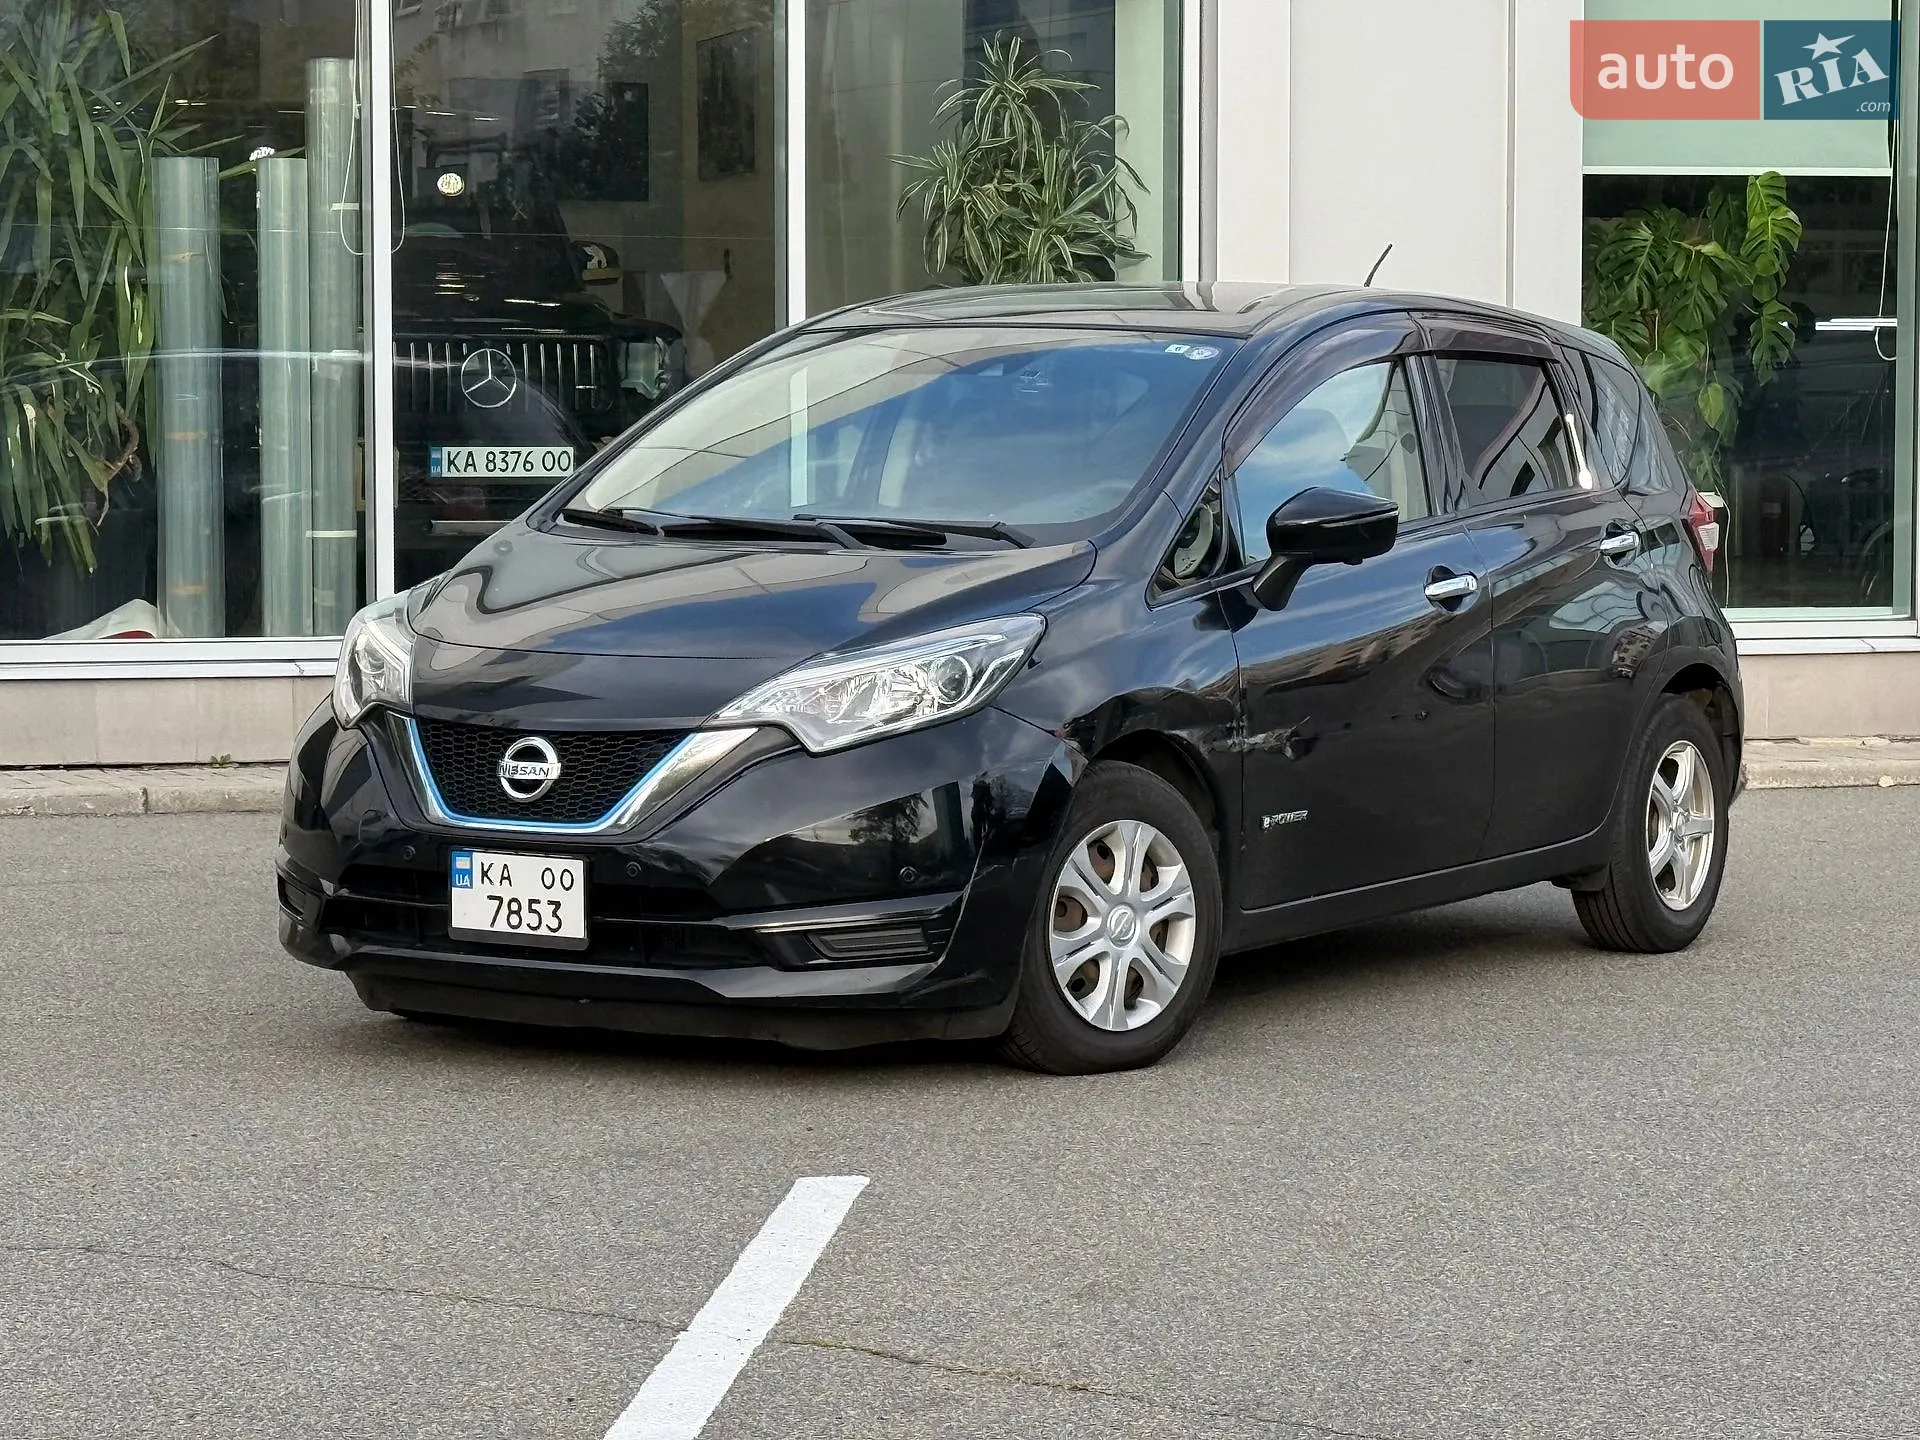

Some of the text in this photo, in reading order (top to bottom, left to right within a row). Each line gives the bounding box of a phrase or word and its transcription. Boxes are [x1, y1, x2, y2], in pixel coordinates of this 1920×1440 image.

[447, 450, 478, 473] KA
[485, 450, 535, 473] 8376
[499, 763, 550, 778] NISSAN
[455, 873, 471, 887] UA
[480, 861, 513, 887] KA
[486, 894, 563, 933] 7853
